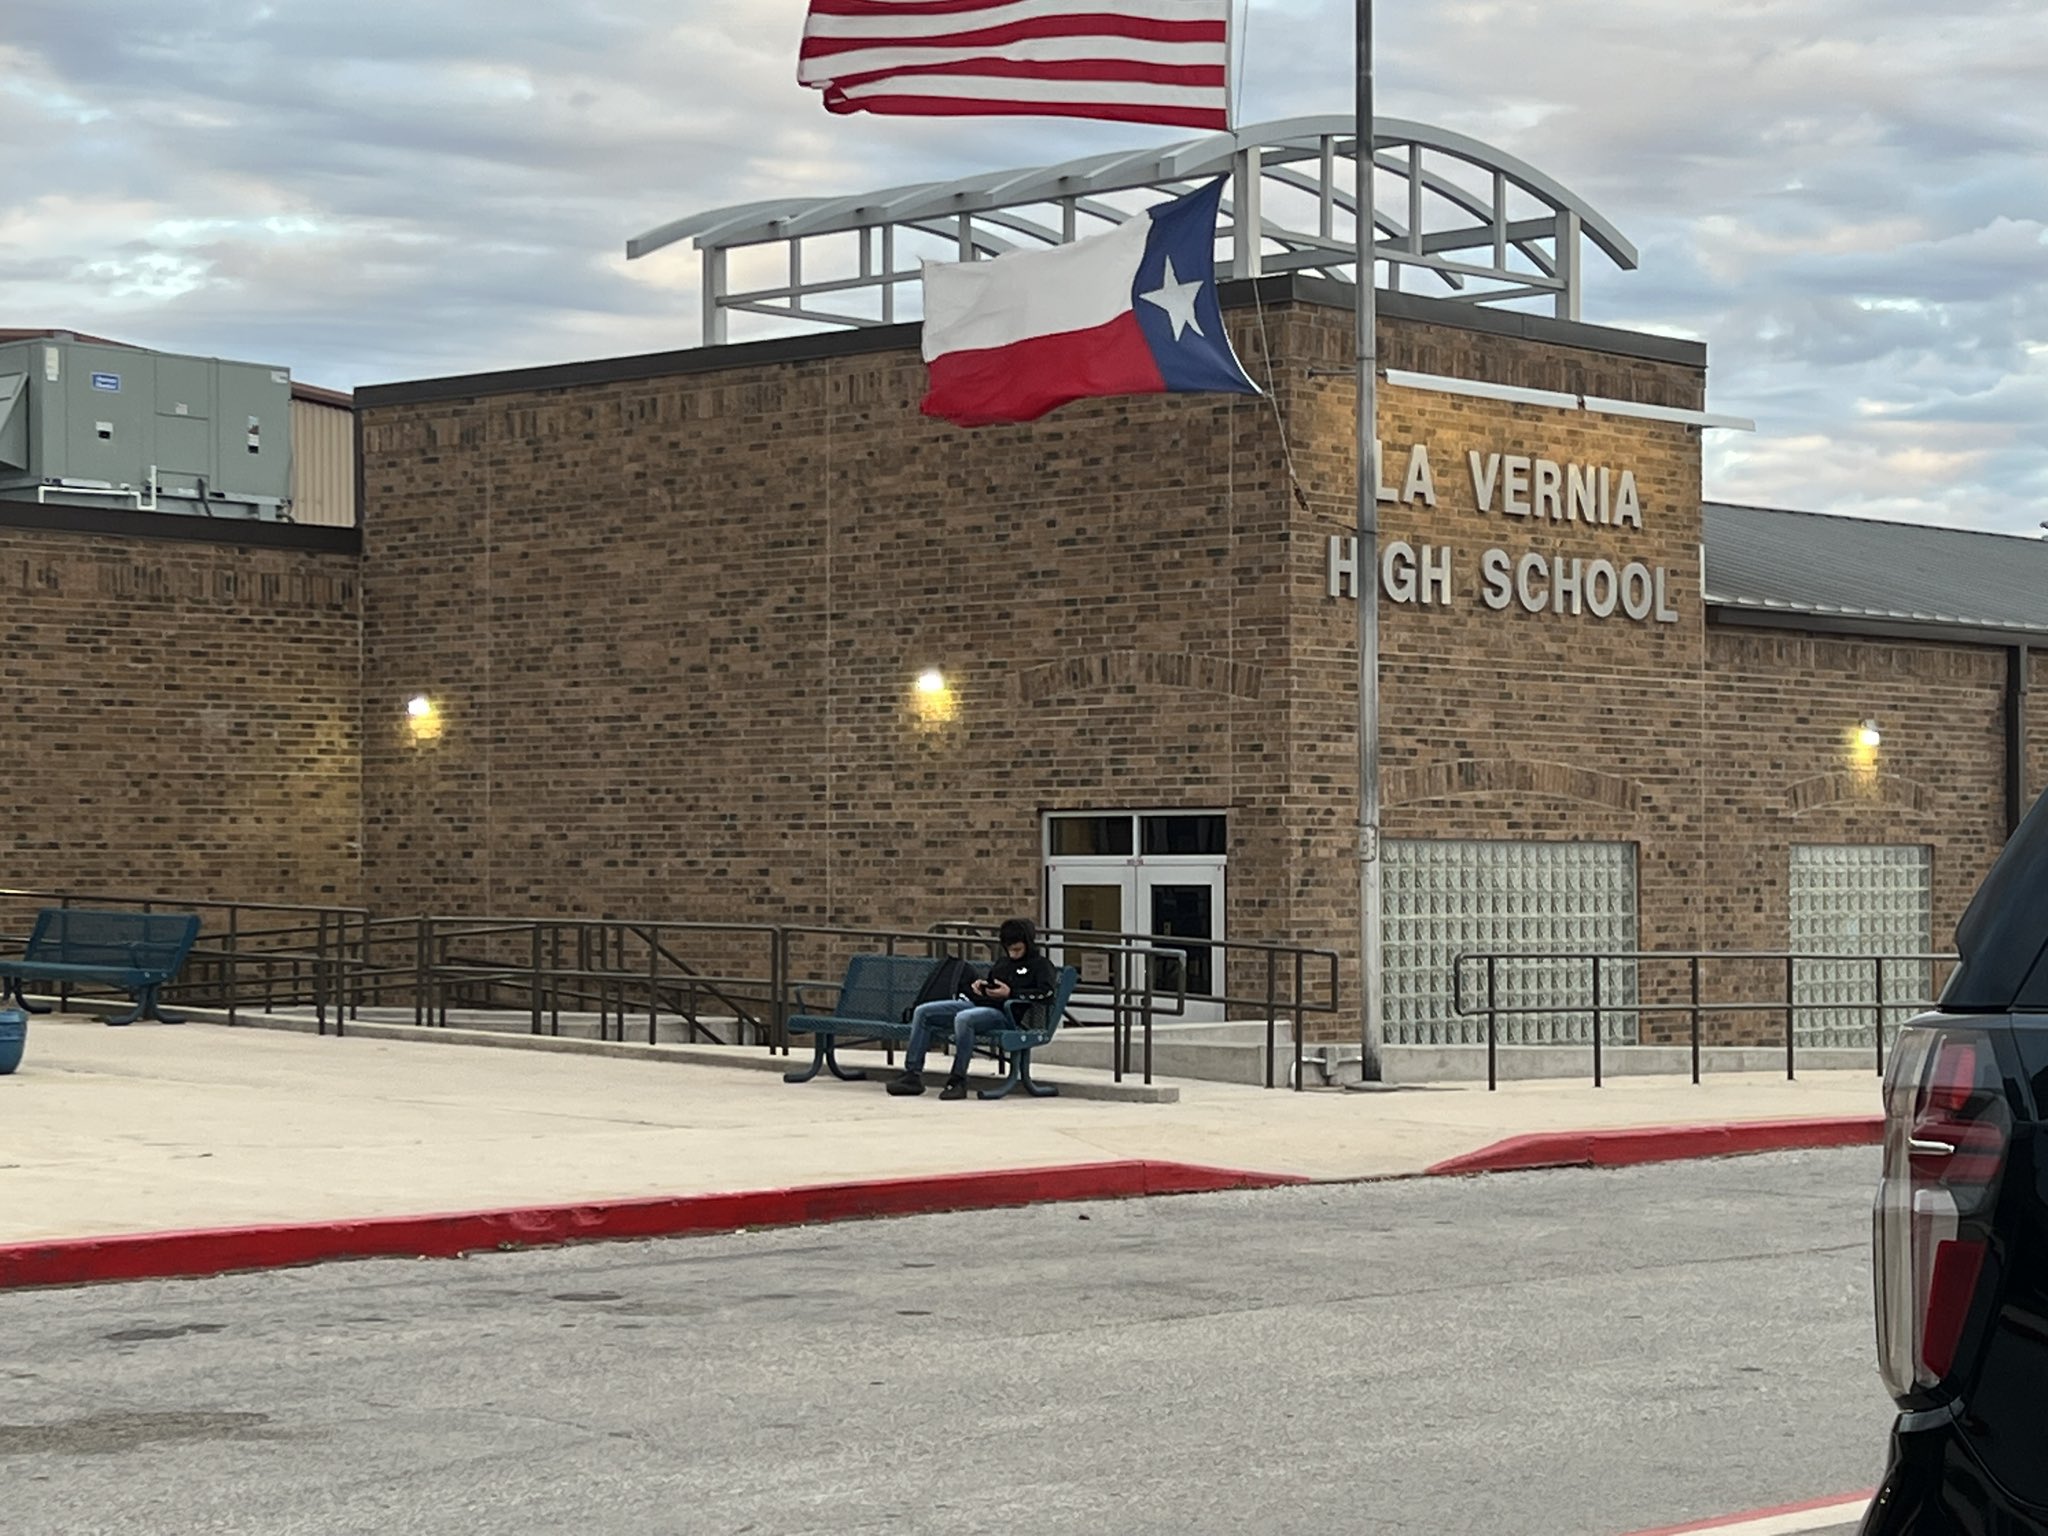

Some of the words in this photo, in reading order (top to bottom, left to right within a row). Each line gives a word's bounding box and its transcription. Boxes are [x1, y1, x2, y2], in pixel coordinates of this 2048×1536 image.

[1375, 439, 1436, 505] LA
[1469, 450, 1642, 528] VERNIA
[1330, 535, 1451, 604] HGH
[1482, 548, 1678, 622] SCHOOL
